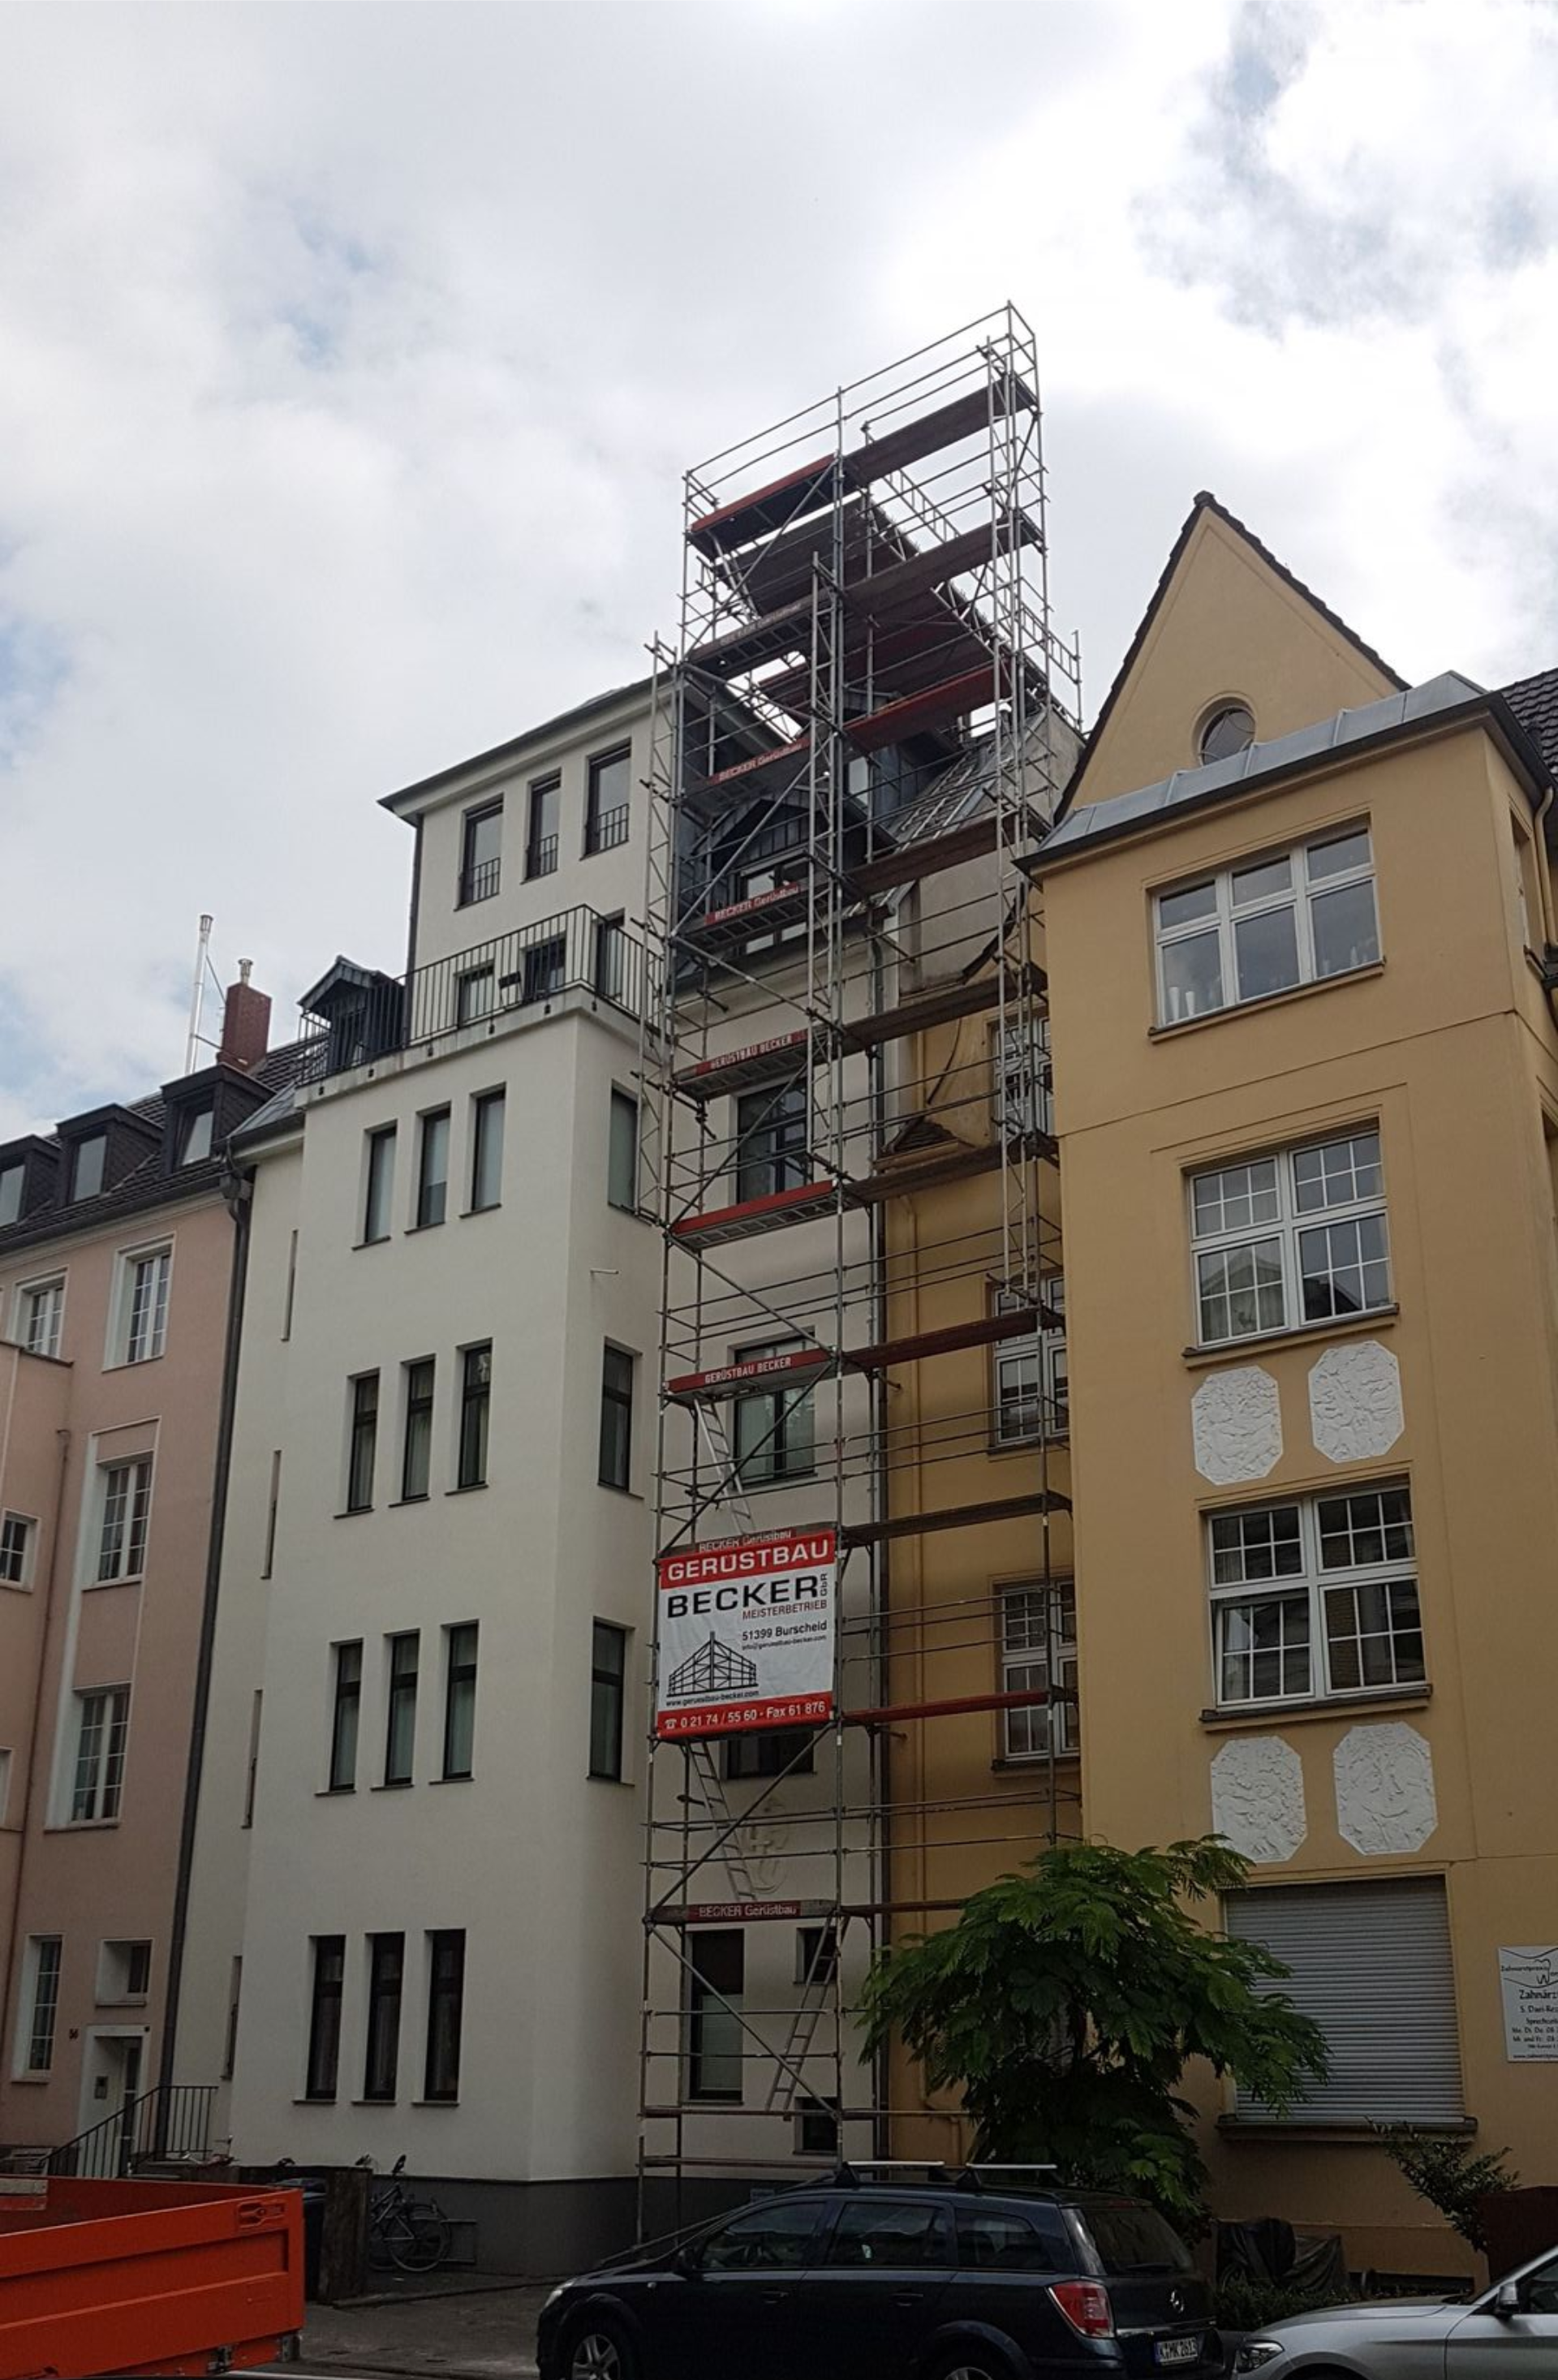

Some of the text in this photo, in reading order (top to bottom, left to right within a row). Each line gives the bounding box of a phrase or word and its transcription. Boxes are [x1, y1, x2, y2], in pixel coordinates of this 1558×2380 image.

[715, 901, 753, 920] BECKER
[705, 1357, 792, 1384] GERÜSTBAU BECKER
[668, 1539, 828, 1581] GERÜSTBAU
[667, 1575, 819, 1619] BECKER
[742, 1599, 828, 1620] MEISTERBETRIEB
[742, 1620, 828, 1642] 51399 Burscheid
[680, 1716, 688, 1728] 0
[690, 1715, 702, 1728] 21
[706, 1713, 718, 1725] 74
[728, 1711, 742, 1723] 55
[744, 1709, 757, 1721] 60
[766, 1706, 786, 1719] Fax
[788, 1704, 802, 1716] 61
[804, 1701, 826, 1715] 876
[699, 1905, 742, 1917] BECKER
